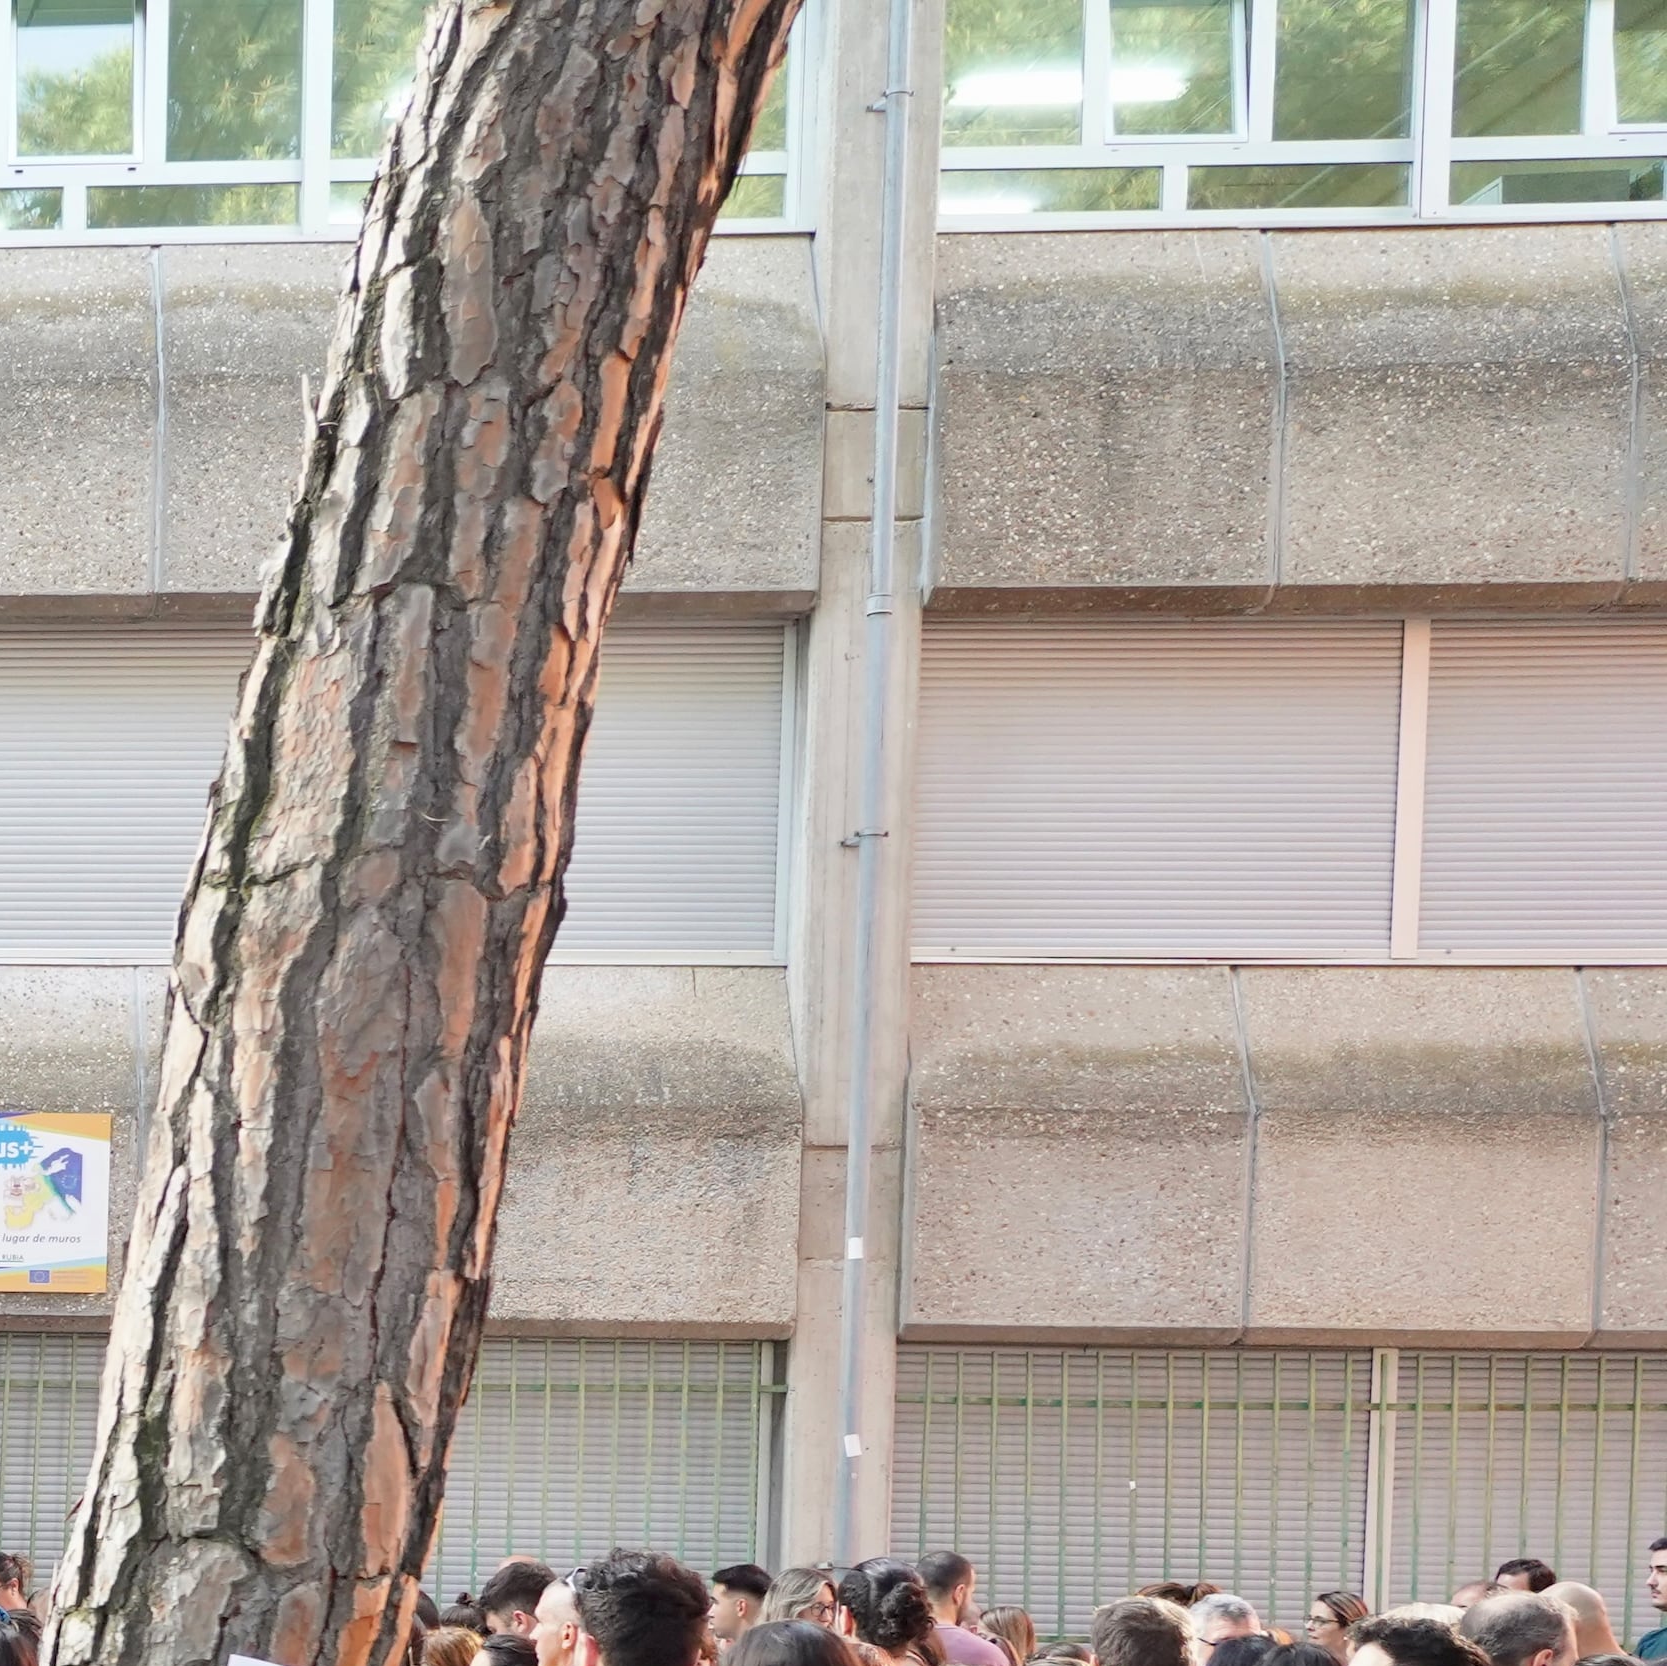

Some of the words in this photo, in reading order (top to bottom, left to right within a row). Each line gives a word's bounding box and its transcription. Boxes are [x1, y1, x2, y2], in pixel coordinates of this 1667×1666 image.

[3, 1233, 30, 1244] lugar
[33, 1233, 46, 1242] de
[49, 1235, 81, 1243] muros
